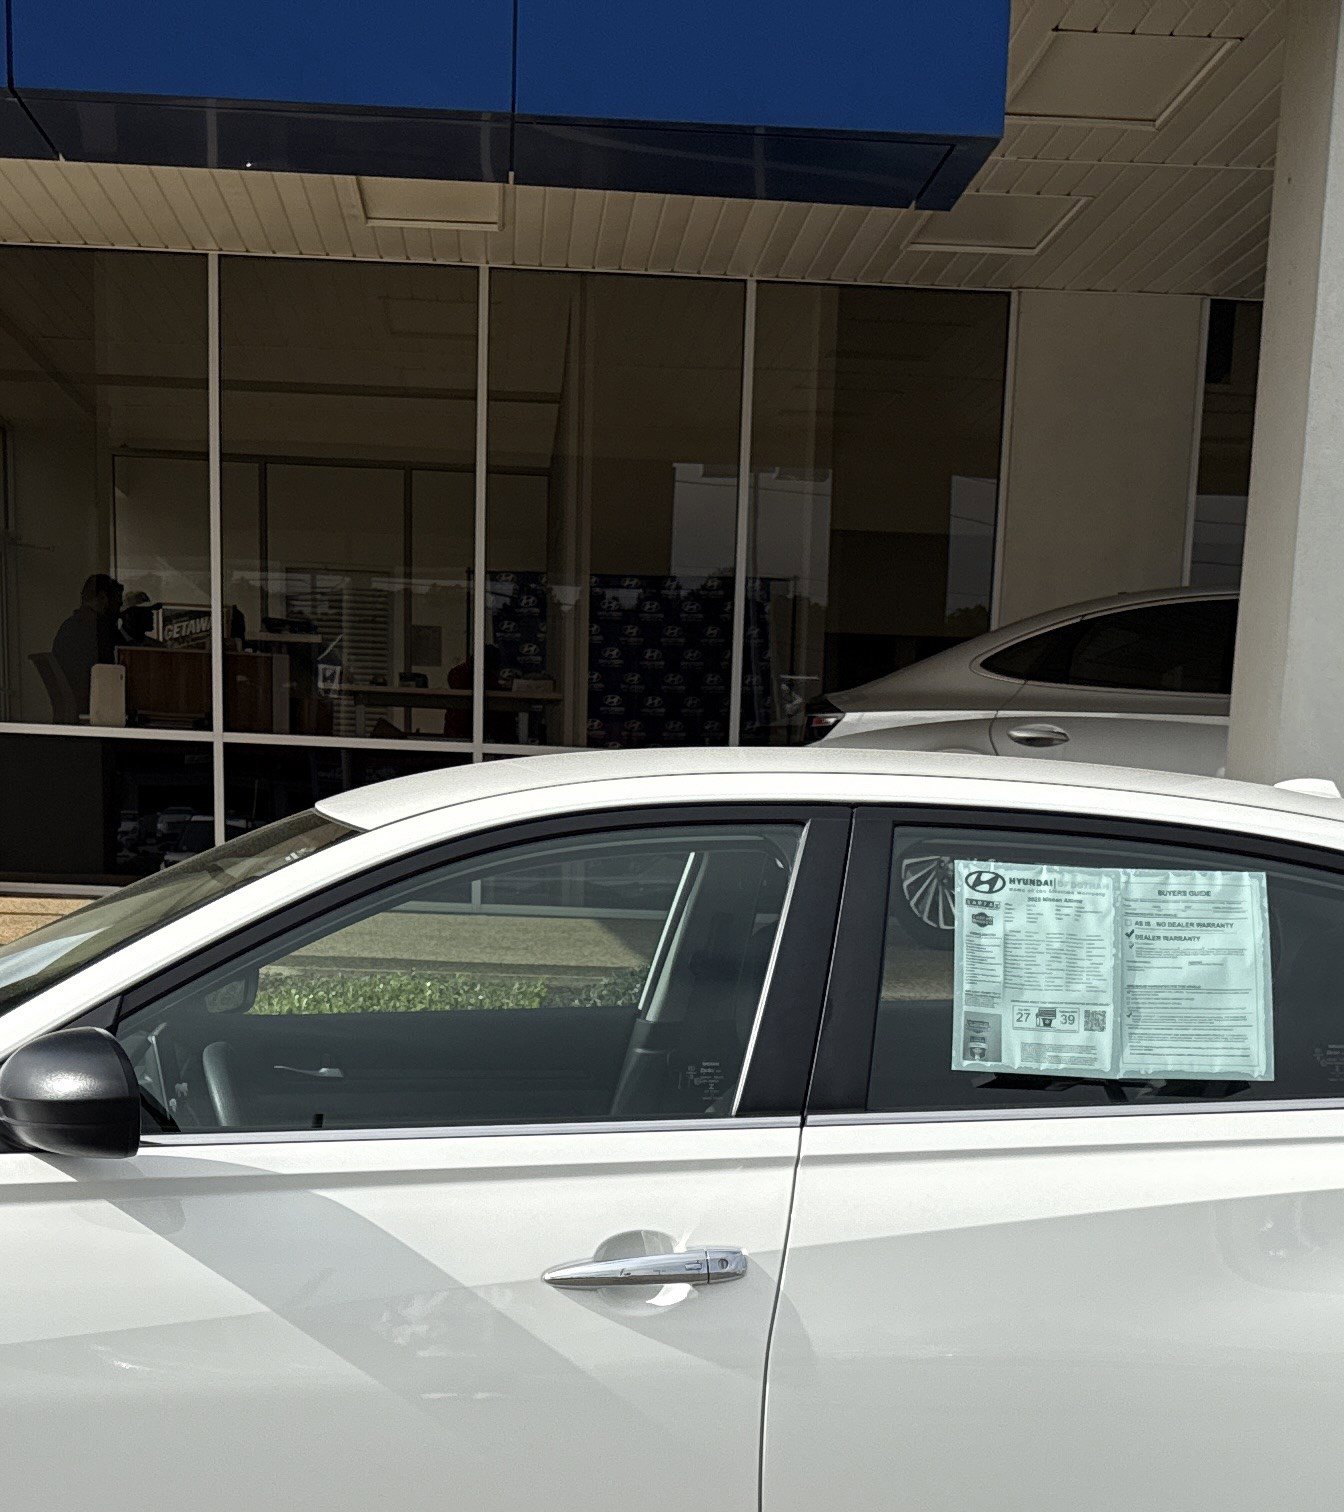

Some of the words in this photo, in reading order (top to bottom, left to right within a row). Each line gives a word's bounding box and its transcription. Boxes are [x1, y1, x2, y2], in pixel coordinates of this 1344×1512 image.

[1008, 876, 1053, 887] HYUNDAI
[1157, 889, 1188, 897] BUYERS
[1015, 1011, 1031, 1023] 27
[1060, 1013, 1076, 1025] 39
